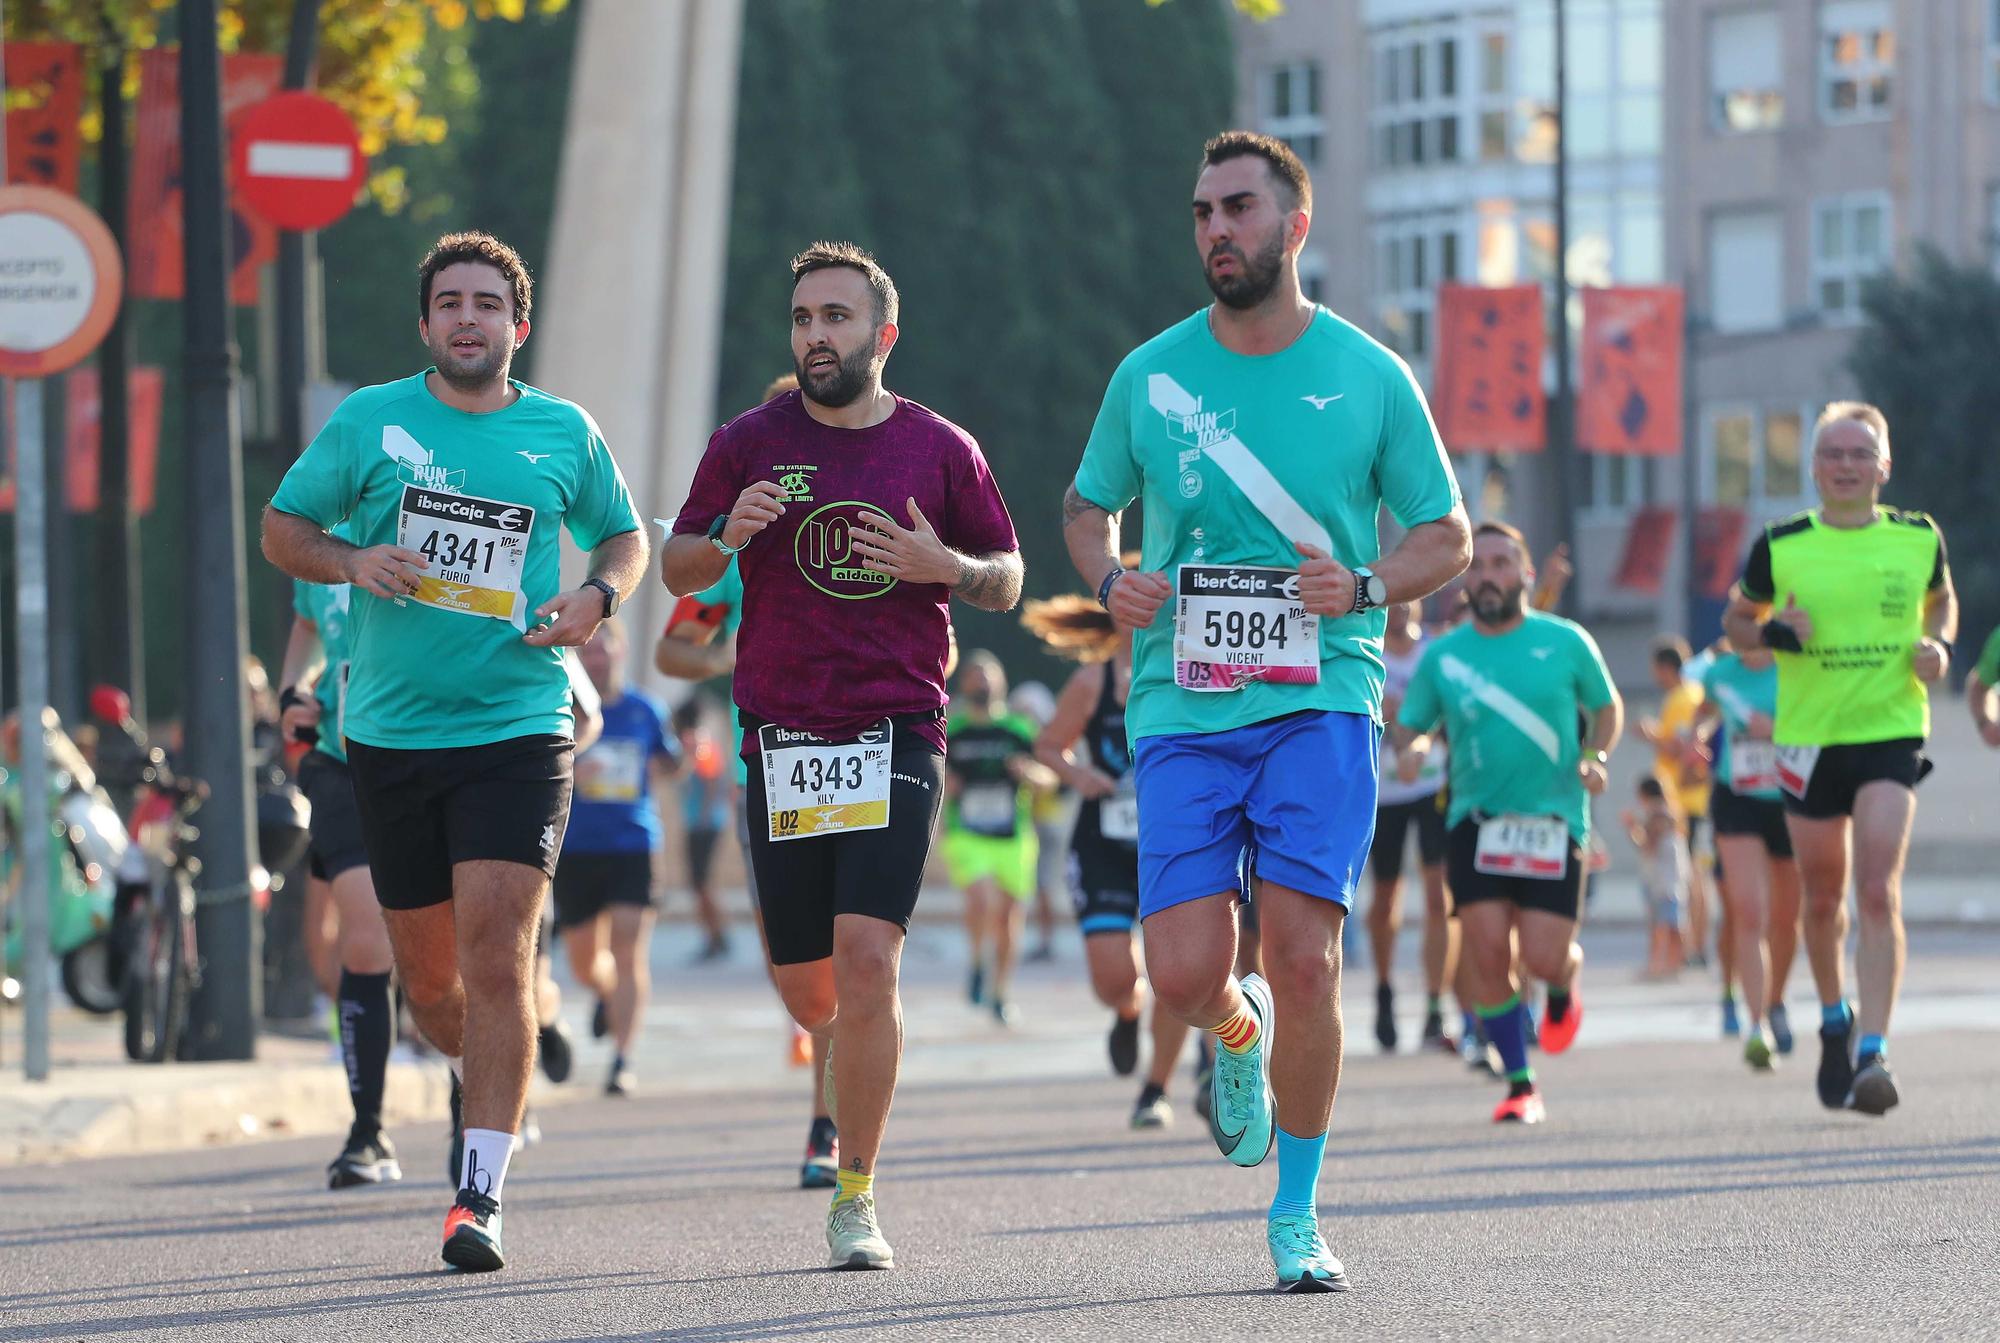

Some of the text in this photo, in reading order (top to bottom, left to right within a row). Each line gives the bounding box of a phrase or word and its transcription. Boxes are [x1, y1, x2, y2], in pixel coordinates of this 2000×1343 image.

[1183, 412, 1217, 434] RUN
[413, 464, 447, 484] RUN
[416, 494, 485, 521] iberCaja
[420, 529, 495, 574] 4341
[440, 569, 470, 584] FURIO
[836, 569, 885, 583] aldaia
[1193, 572, 1267, 594] iberCaja
[1204, 610, 1288, 650] 5984
[1226, 652, 1265, 665] VICENT
[1188, 661, 1212, 682] 03
[775, 728, 832, 743] iberC
[790, 756, 863, 793] 4343
[890, 772, 920, 786] uanvi
[817, 793, 835, 806] KILY
[779, 810, 799, 830] 02
